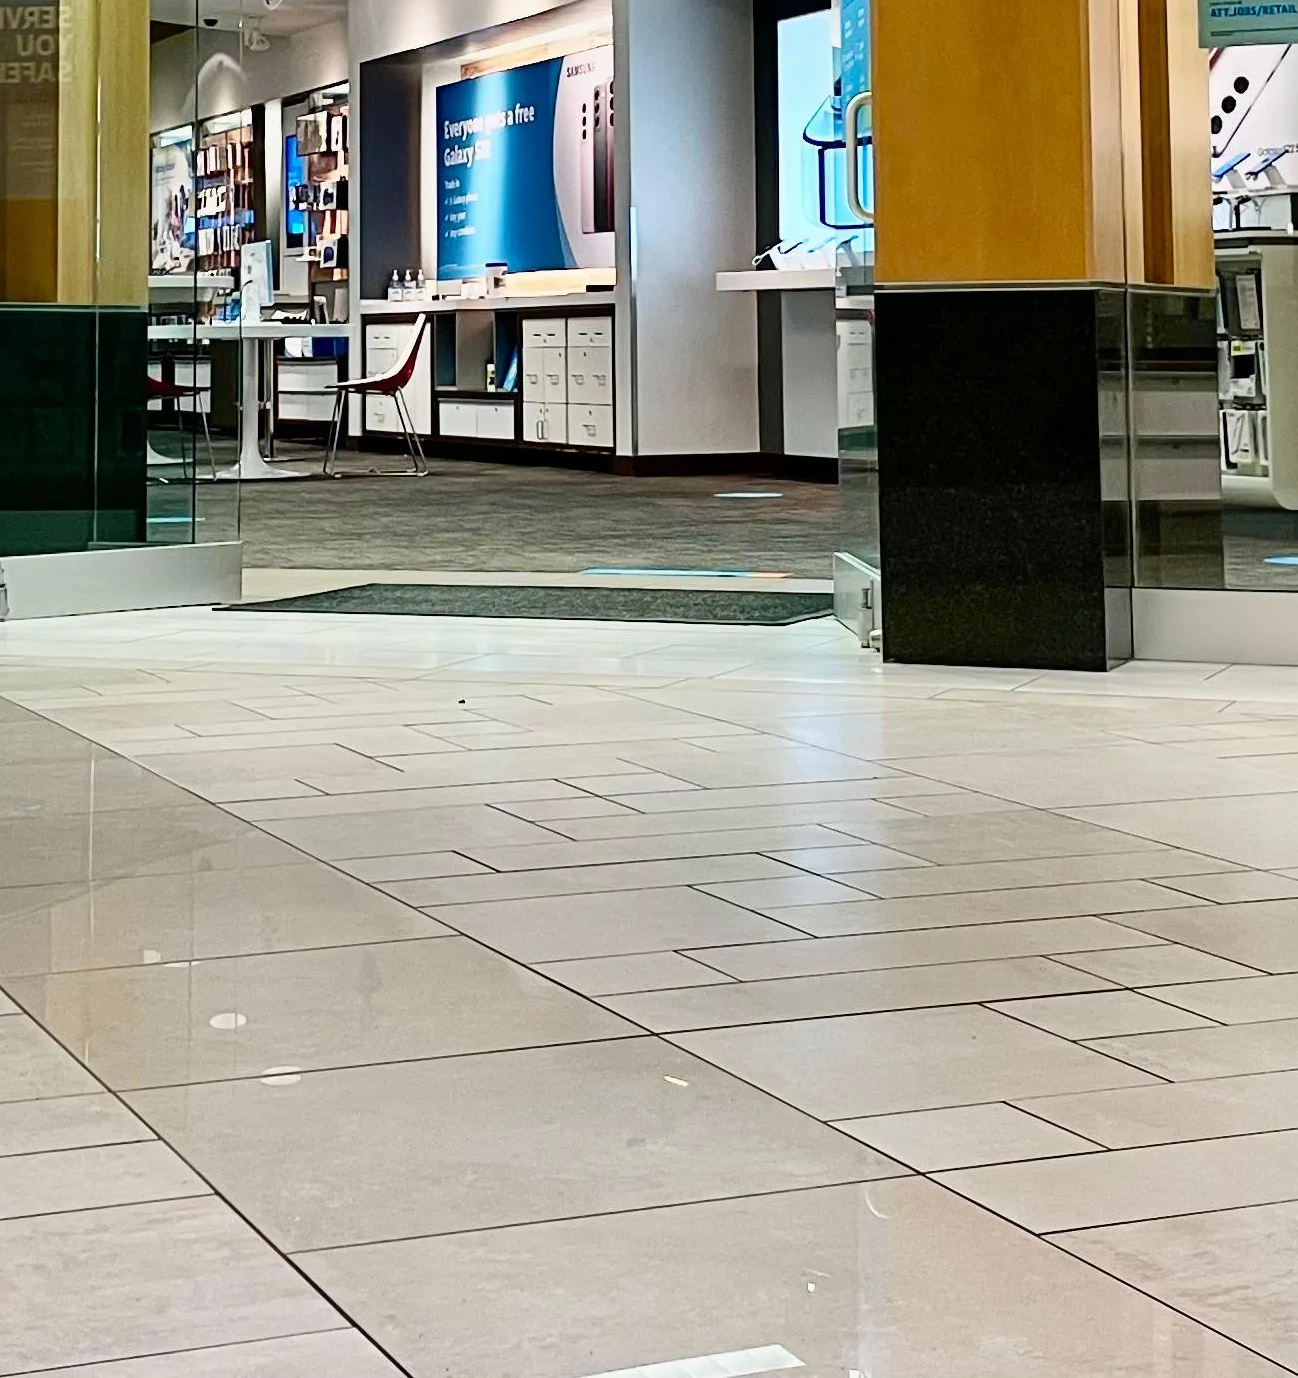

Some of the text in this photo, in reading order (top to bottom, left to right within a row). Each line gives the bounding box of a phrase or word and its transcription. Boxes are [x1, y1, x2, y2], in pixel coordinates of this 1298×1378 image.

[507, 110, 514, 126] a
[515, 103, 535, 124] free
[444, 145, 474, 168] Galaxy
